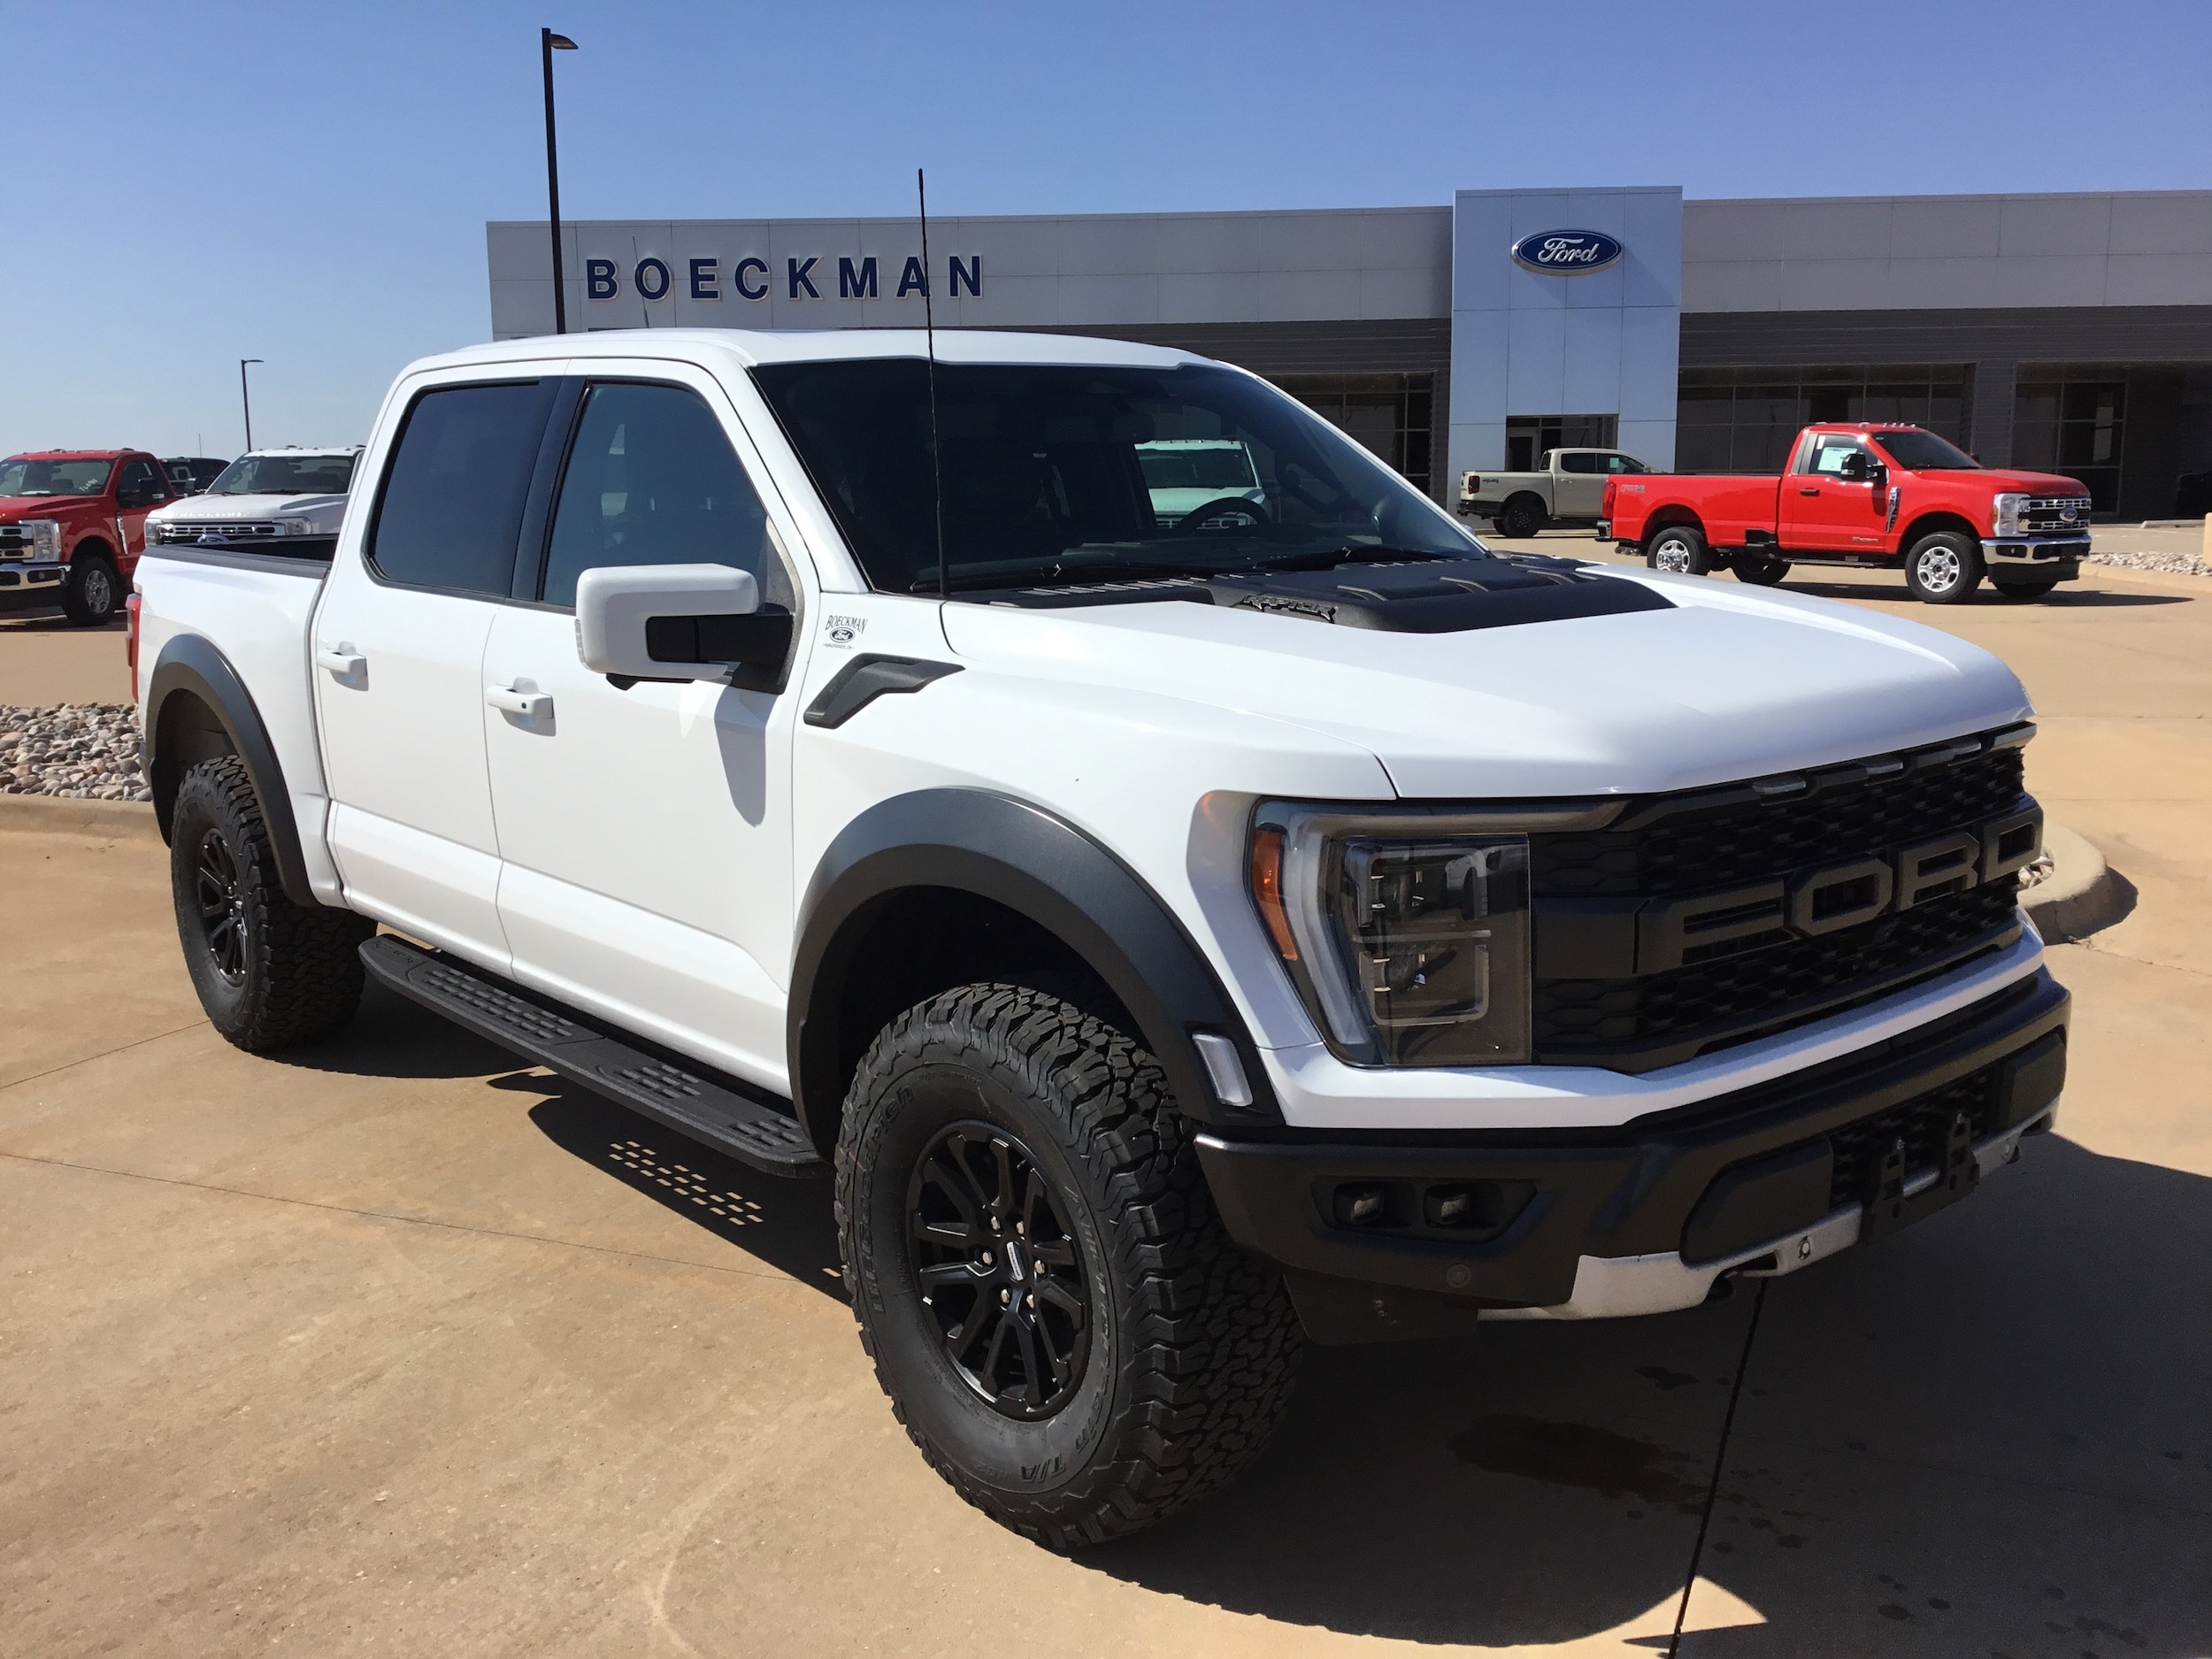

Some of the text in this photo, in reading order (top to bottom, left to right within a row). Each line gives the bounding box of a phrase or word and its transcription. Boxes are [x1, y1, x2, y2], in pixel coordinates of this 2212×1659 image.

[1537, 237, 1601, 263] Ford
[586, 256, 982, 300] BOECKMAN
[1240, 595, 1336, 624] RAPTOR
[825, 615, 868, 634] BOECKMAN
[1640, 805, 2043, 972] FORD
[1021, 1454, 1067, 1484] T/A
